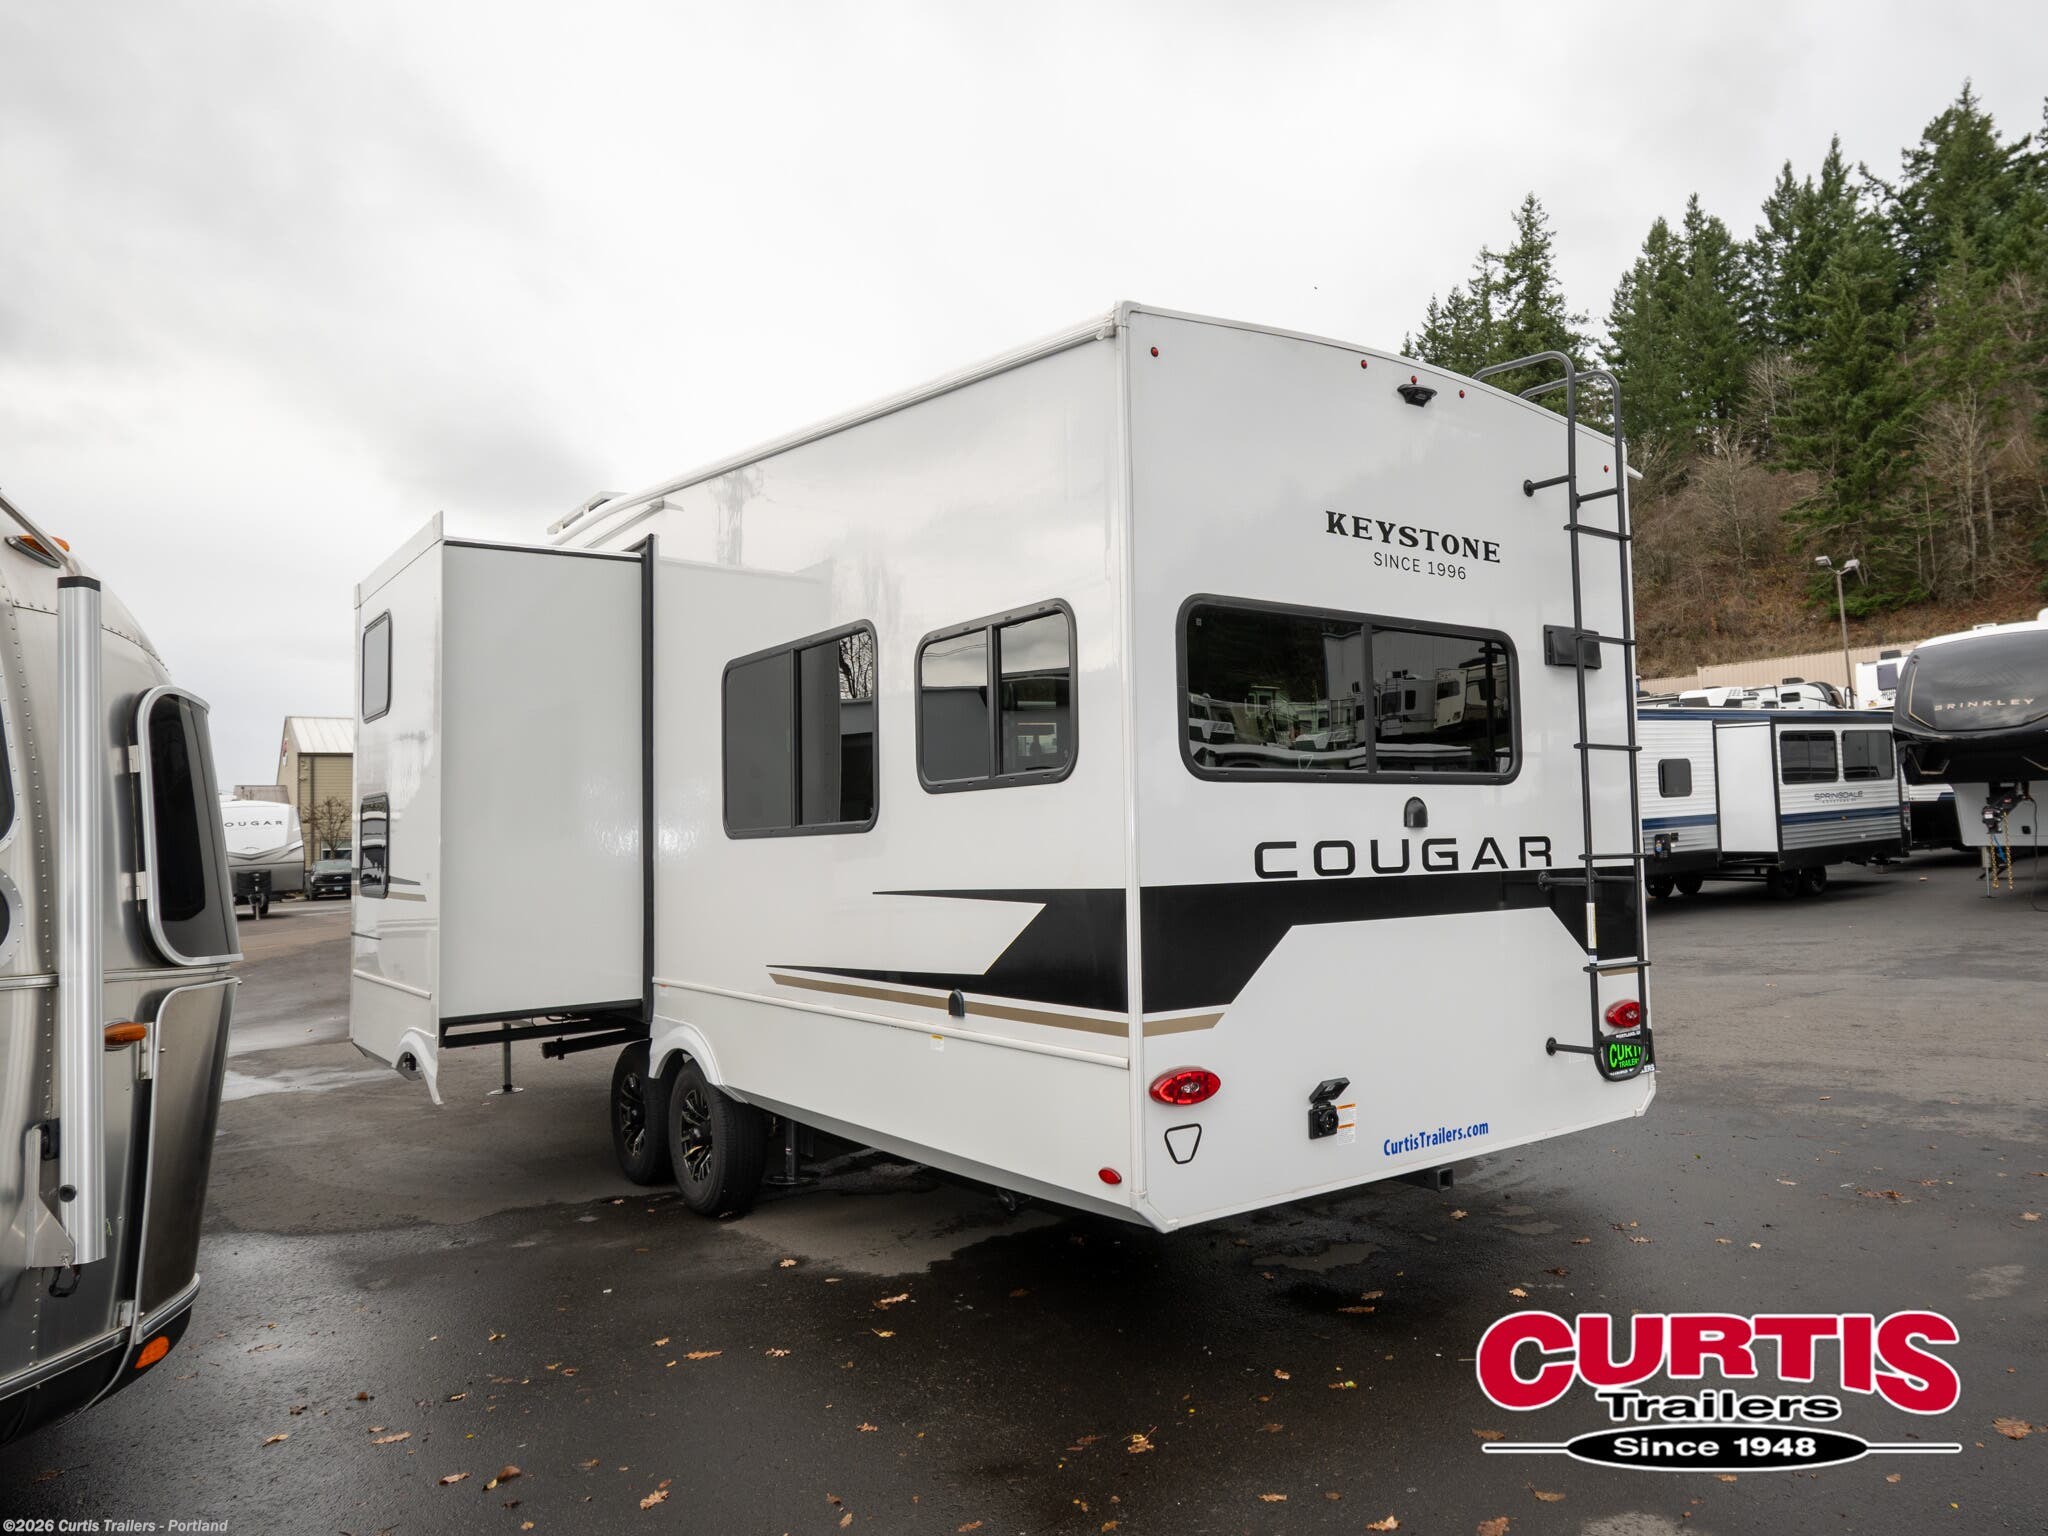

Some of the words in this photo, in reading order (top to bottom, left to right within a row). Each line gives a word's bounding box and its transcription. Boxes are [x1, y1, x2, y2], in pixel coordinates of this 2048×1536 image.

[1325, 511, 1501, 564] KEYSTONE
[1373, 552, 1421, 573] SINCE
[1427, 560, 1468, 581] 1996
[1934, 698, 2035, 712] BRINKLEY
[224, 820, 283, 828] OUGAR
[1254, 836, 1552, 880] COUGAR
[1609, 1043, 1649, 1069] CURTI
[1619, 1058, 1640, 1069] TRAILER
[1383, 1121, 1489, 1157] CurtisTrailers.com
